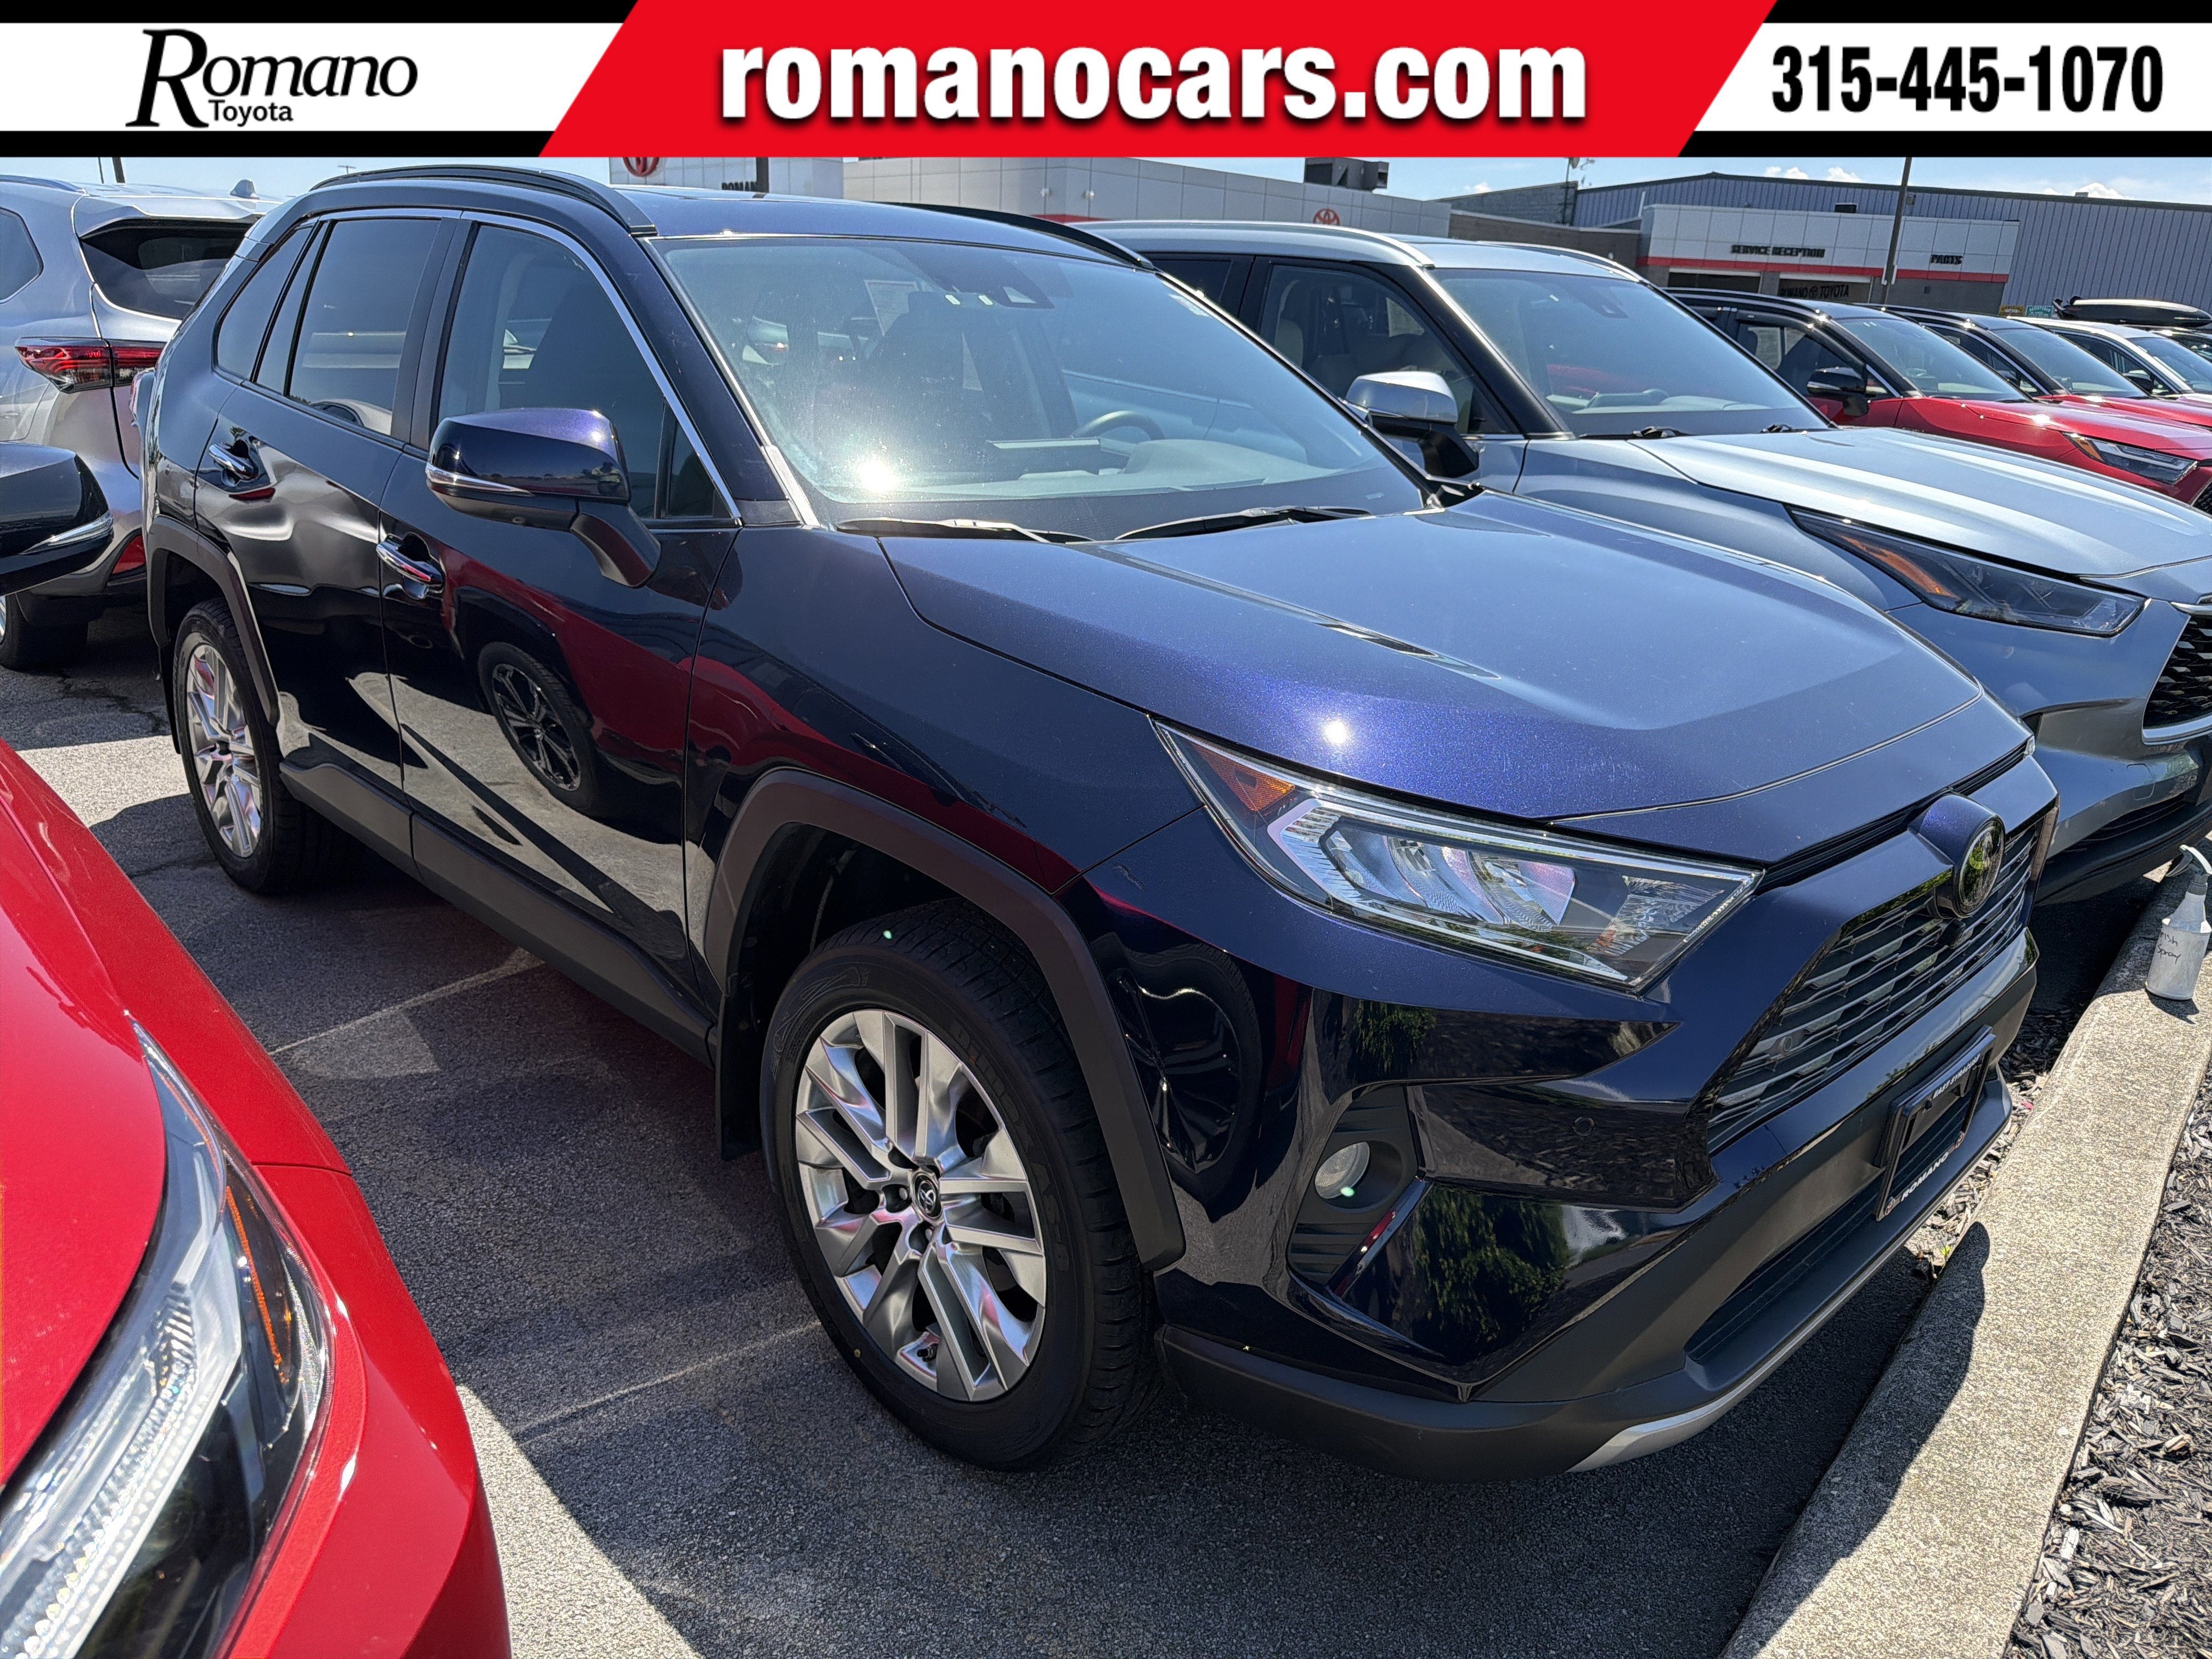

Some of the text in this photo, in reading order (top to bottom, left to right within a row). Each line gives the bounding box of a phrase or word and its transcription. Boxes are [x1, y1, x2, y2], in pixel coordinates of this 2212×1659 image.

[721, 181, 757, 191] ROMAN
[1731, 245, 1826, 258] SERVICE RECEPTION
[1931, 255, 1963, 264] PARTS
[1820, 284, 1849, 298] TOYOTA
[2157, 943, 2181, 964] Spray
[1900, 1152, 1949, 1202] ROMANO
